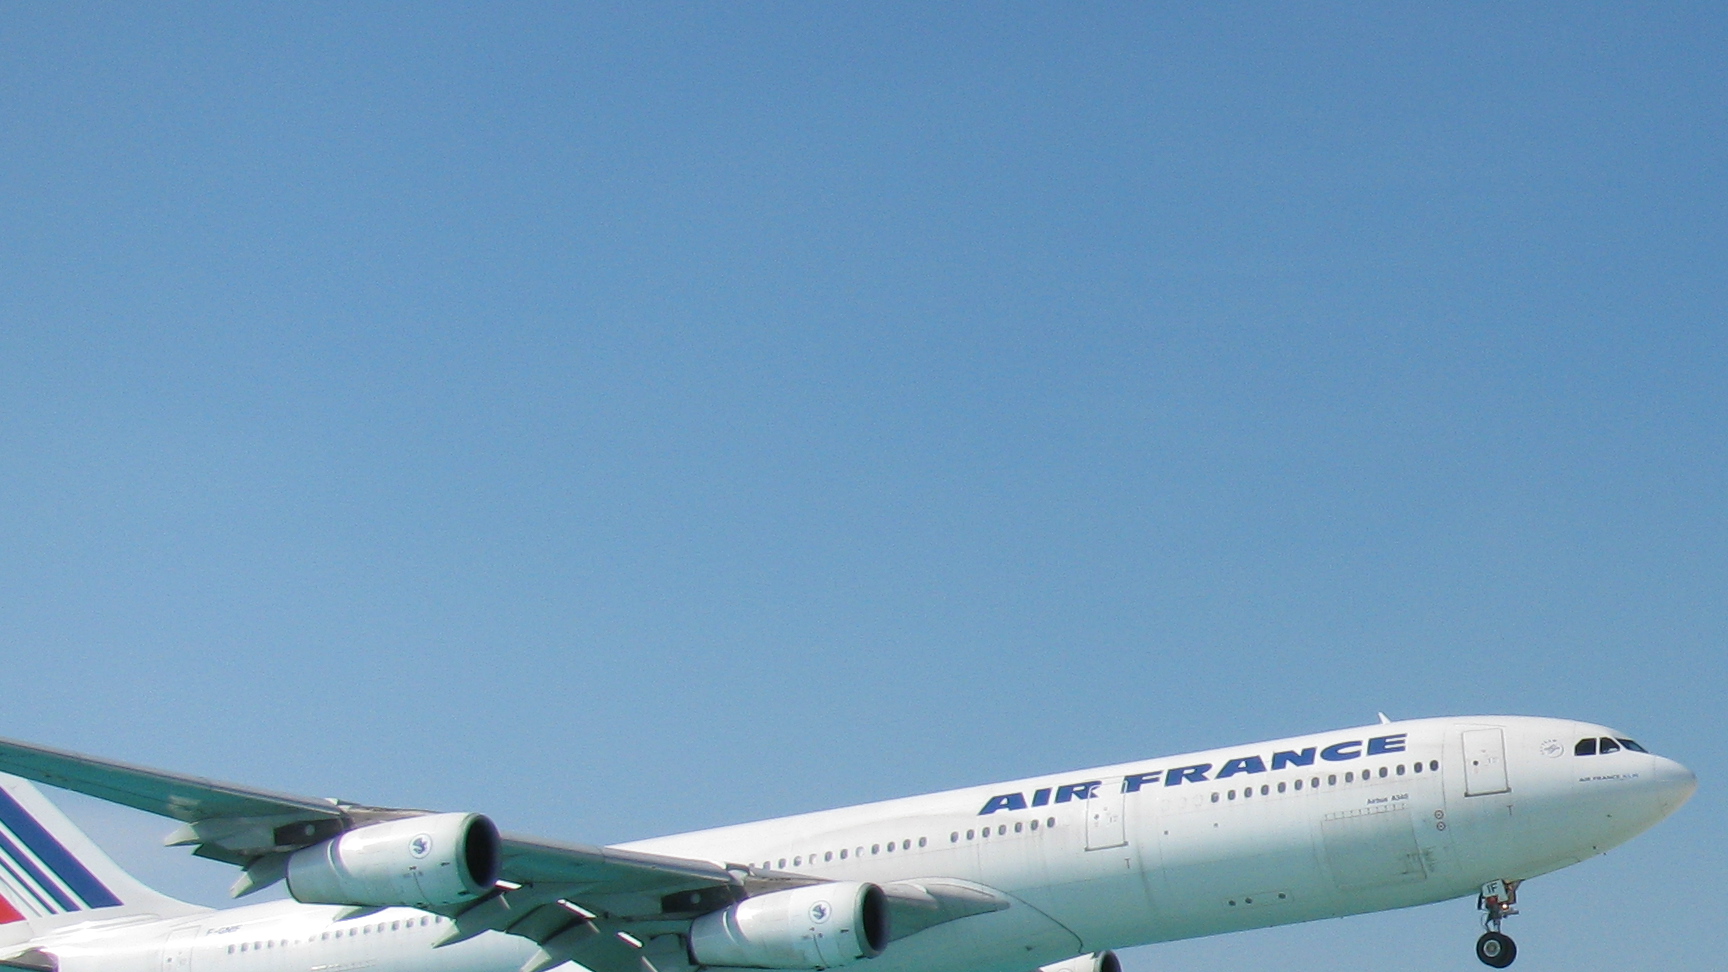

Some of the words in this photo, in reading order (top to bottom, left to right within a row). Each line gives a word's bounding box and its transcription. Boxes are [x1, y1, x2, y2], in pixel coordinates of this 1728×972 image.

[978, 780, 1102, 816] AIR
[1121, 733, 1408, 794] FRANCE
[1486, 882, 1498, 893] IF
